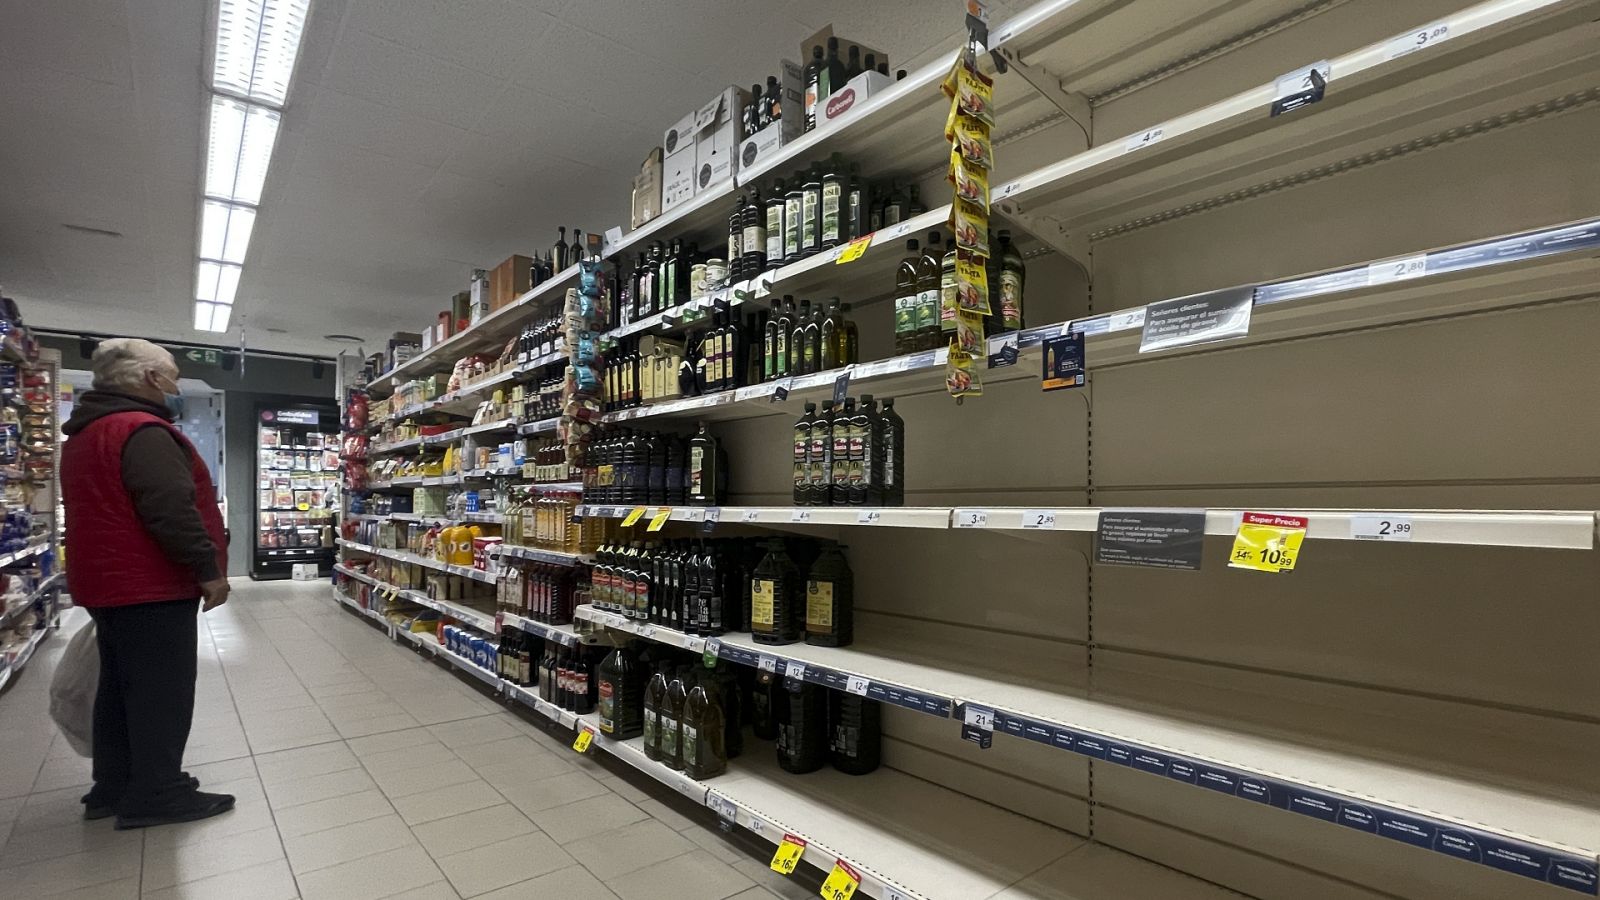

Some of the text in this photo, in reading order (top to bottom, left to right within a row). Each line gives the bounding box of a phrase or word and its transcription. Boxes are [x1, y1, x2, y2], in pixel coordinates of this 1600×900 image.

[1394, 261, 1424, 276] 2,80
[1151, 302, 1209, 318] Señores clientes:
[1149, 319, 1166, 328] Para
[1167, 313, 1199, 325] asegurar
[1199, 311, 1206, 319] el
[1158, 324, 1181, 332] aceite
[1181, 322, 1190, 330] de
[1249, 515, 1301, 528] Super Precio
[1379, 521, 1411, 536] 2,99
